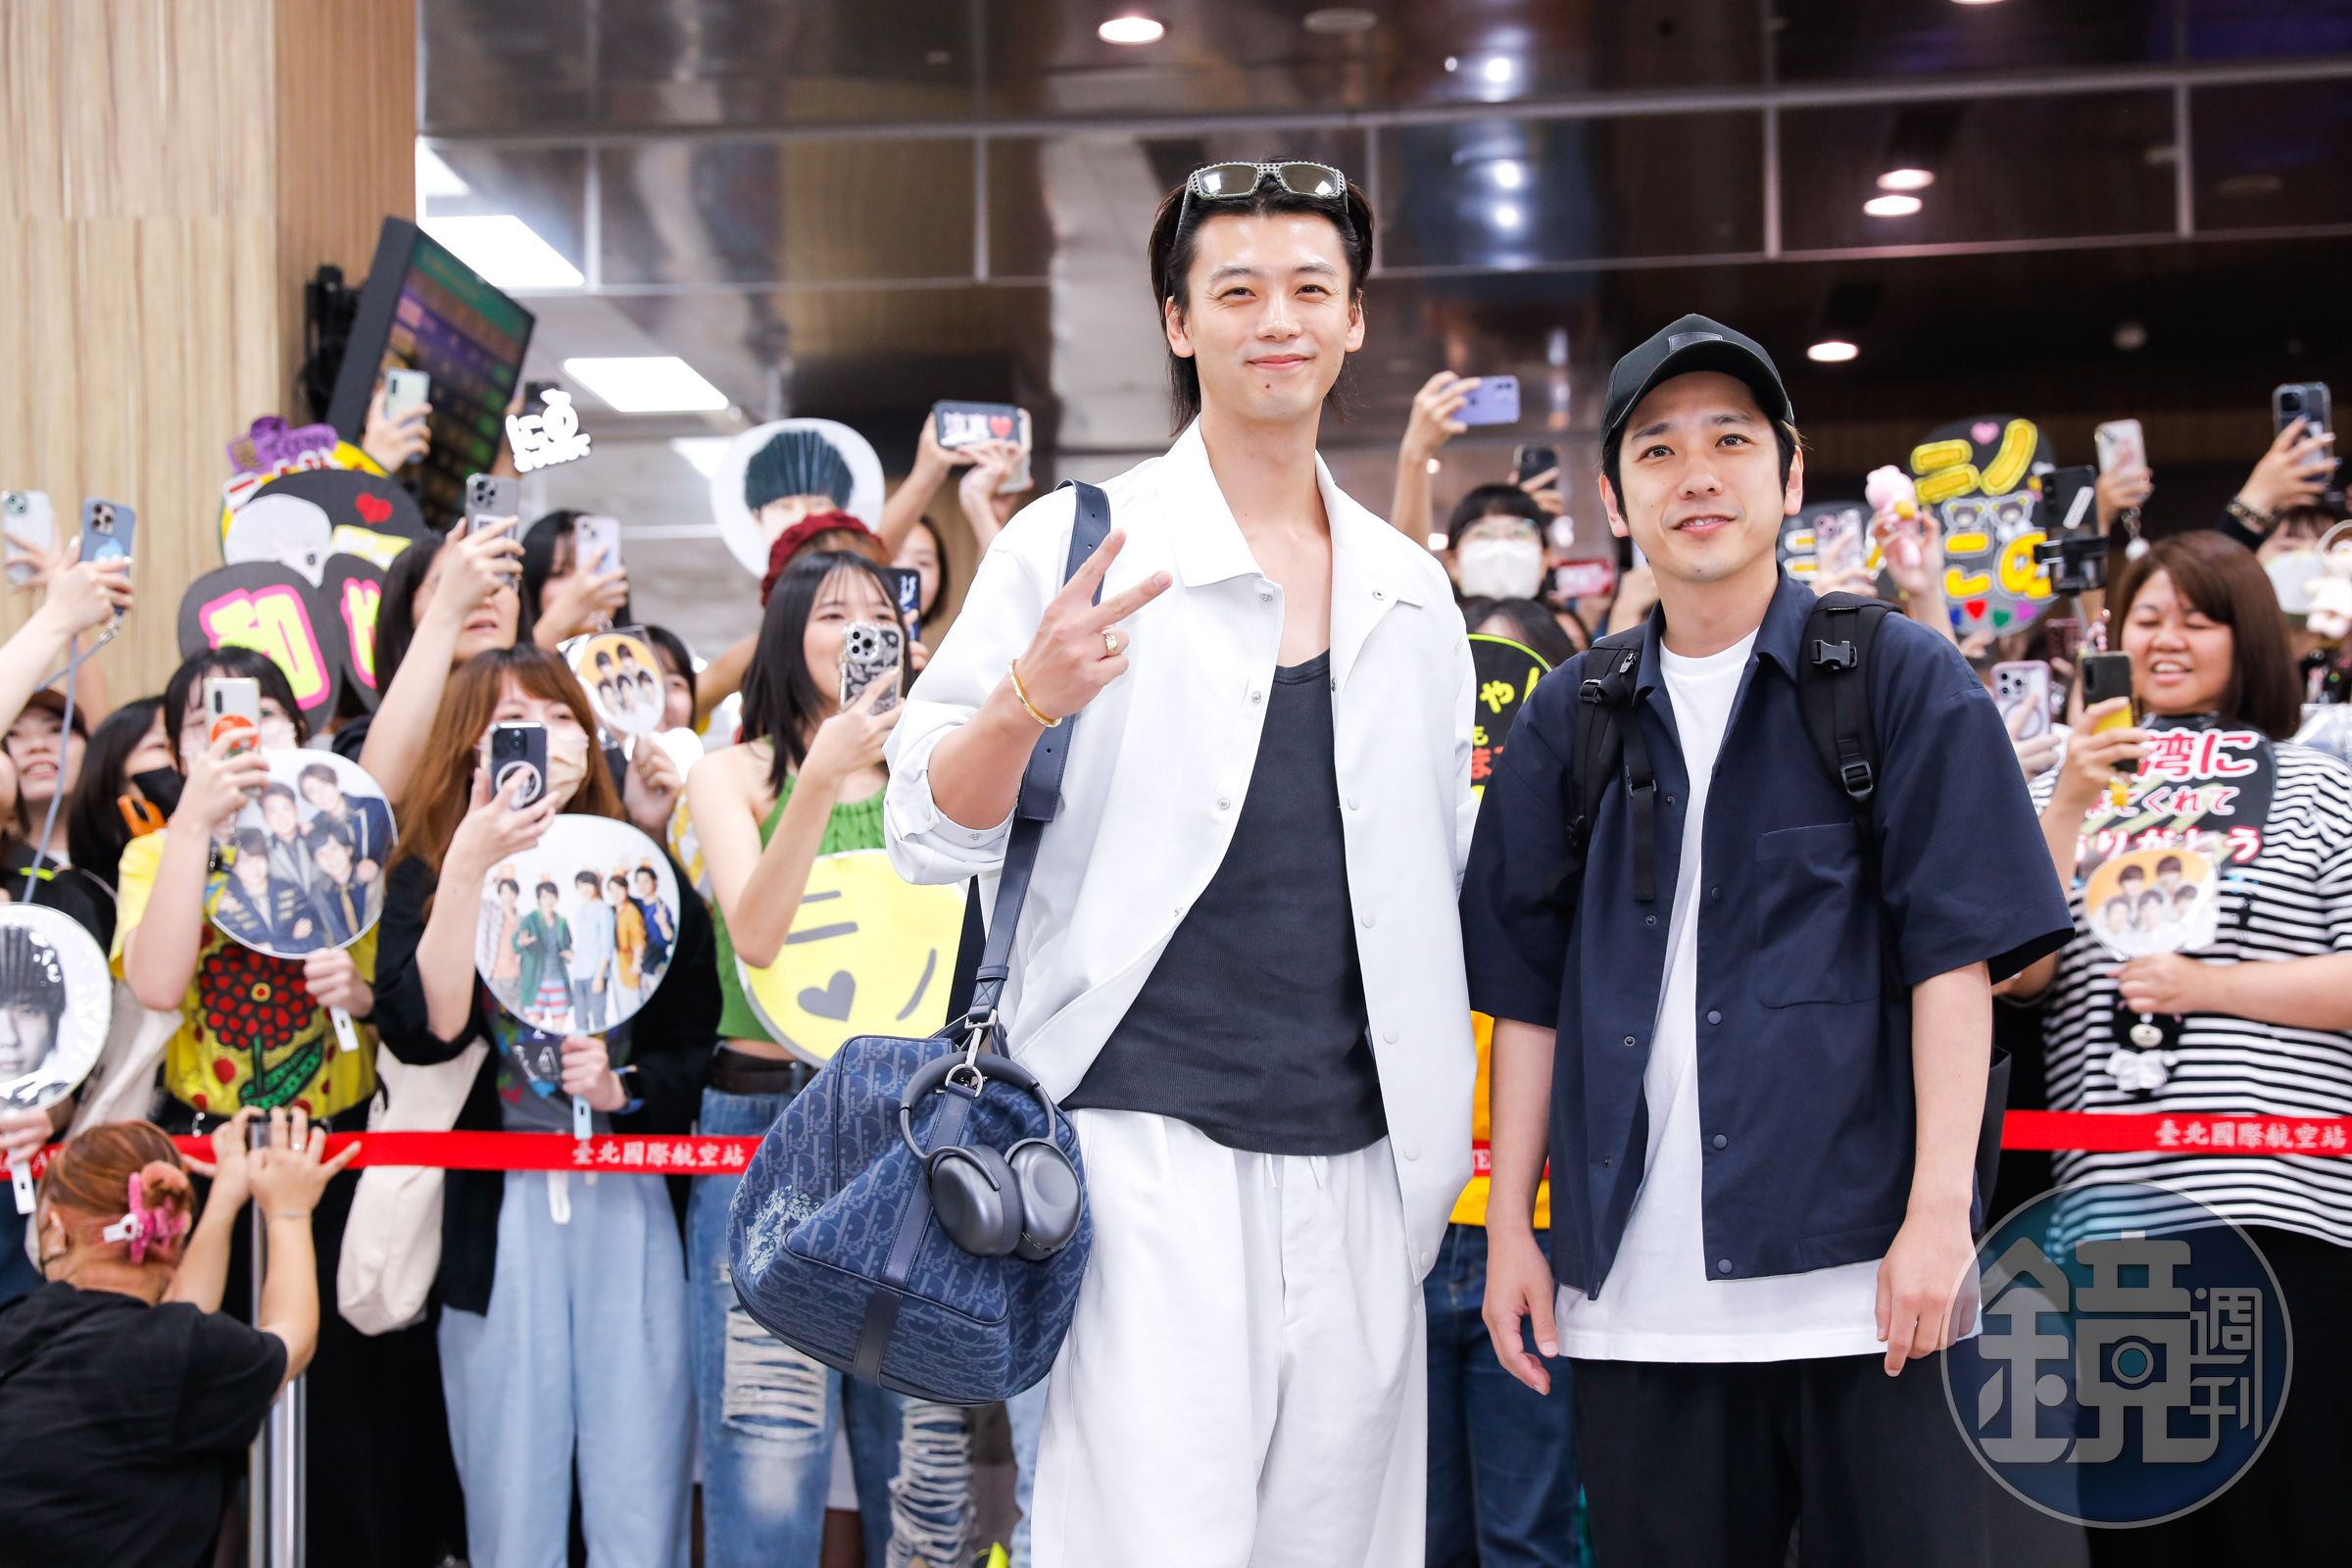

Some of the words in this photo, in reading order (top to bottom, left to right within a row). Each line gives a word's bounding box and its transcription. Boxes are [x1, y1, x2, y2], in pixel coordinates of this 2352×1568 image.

[2075, 826, 2263, 863] りがとう
[2155, 1118, 2347, 1150] 臺北國際航空站
[571, 1140, 745, 1167] 臺北國際航空站
